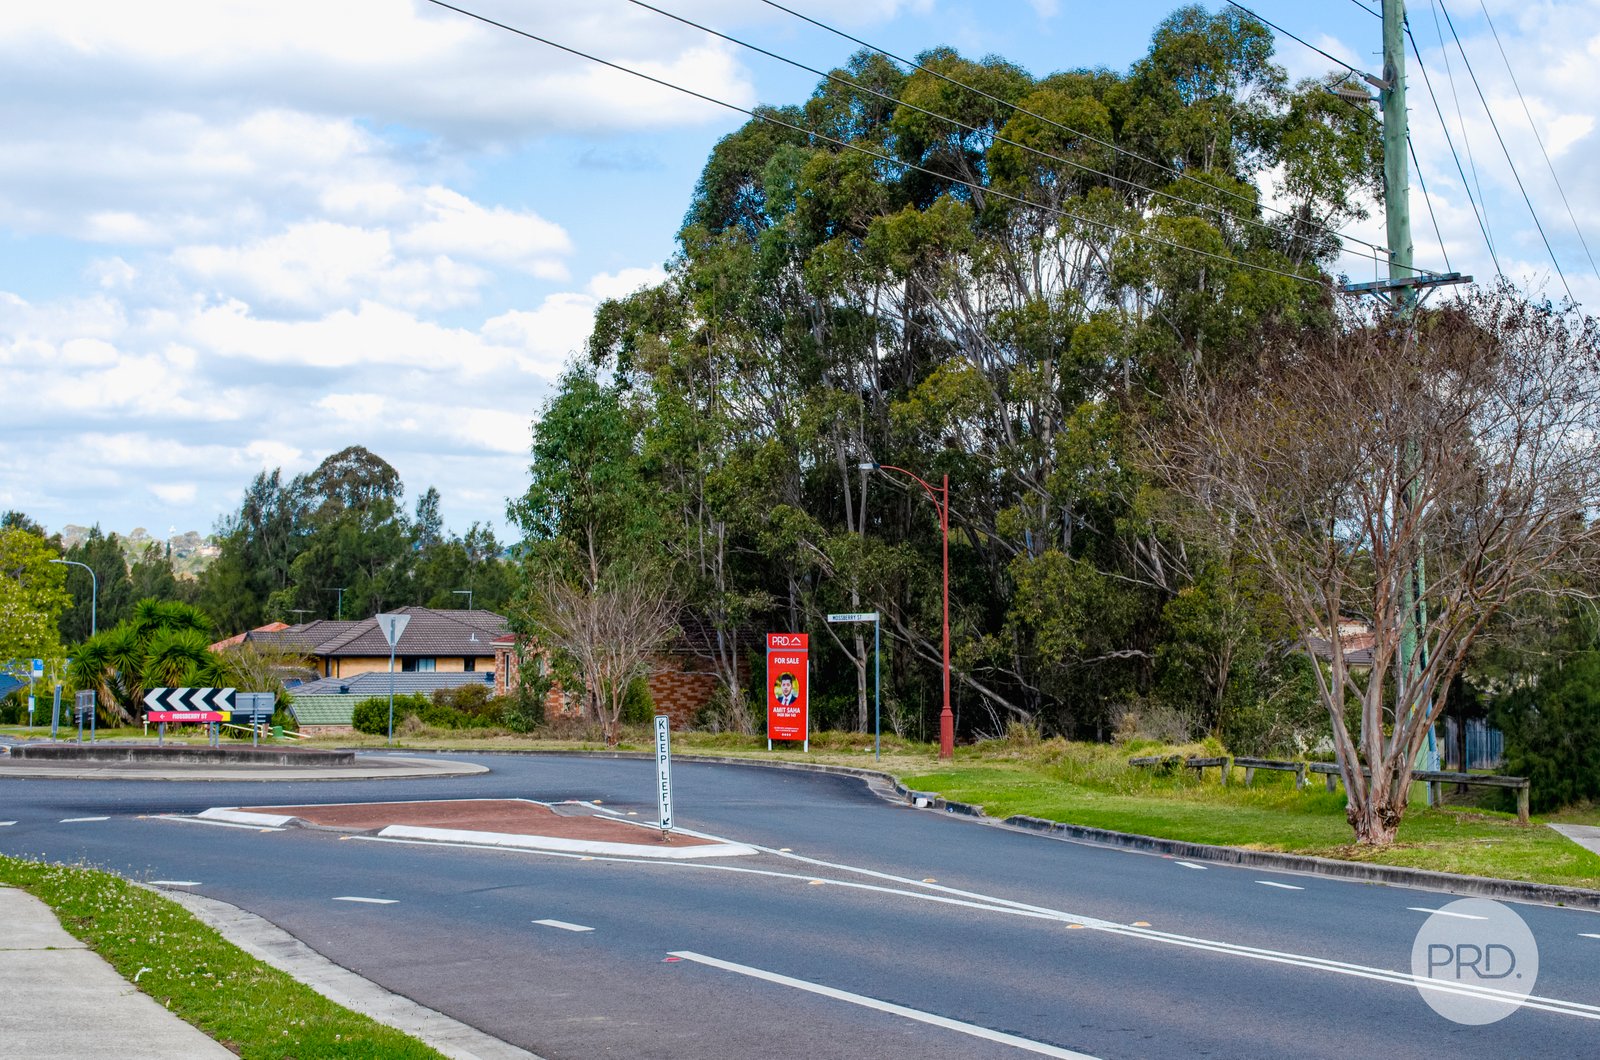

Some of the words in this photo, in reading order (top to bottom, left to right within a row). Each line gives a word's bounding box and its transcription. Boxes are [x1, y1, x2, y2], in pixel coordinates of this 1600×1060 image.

[786, 657, 800, 665] SALE
[658, 720, 667, 764] KEEP
[661, 771, 669, 813] LEFT
